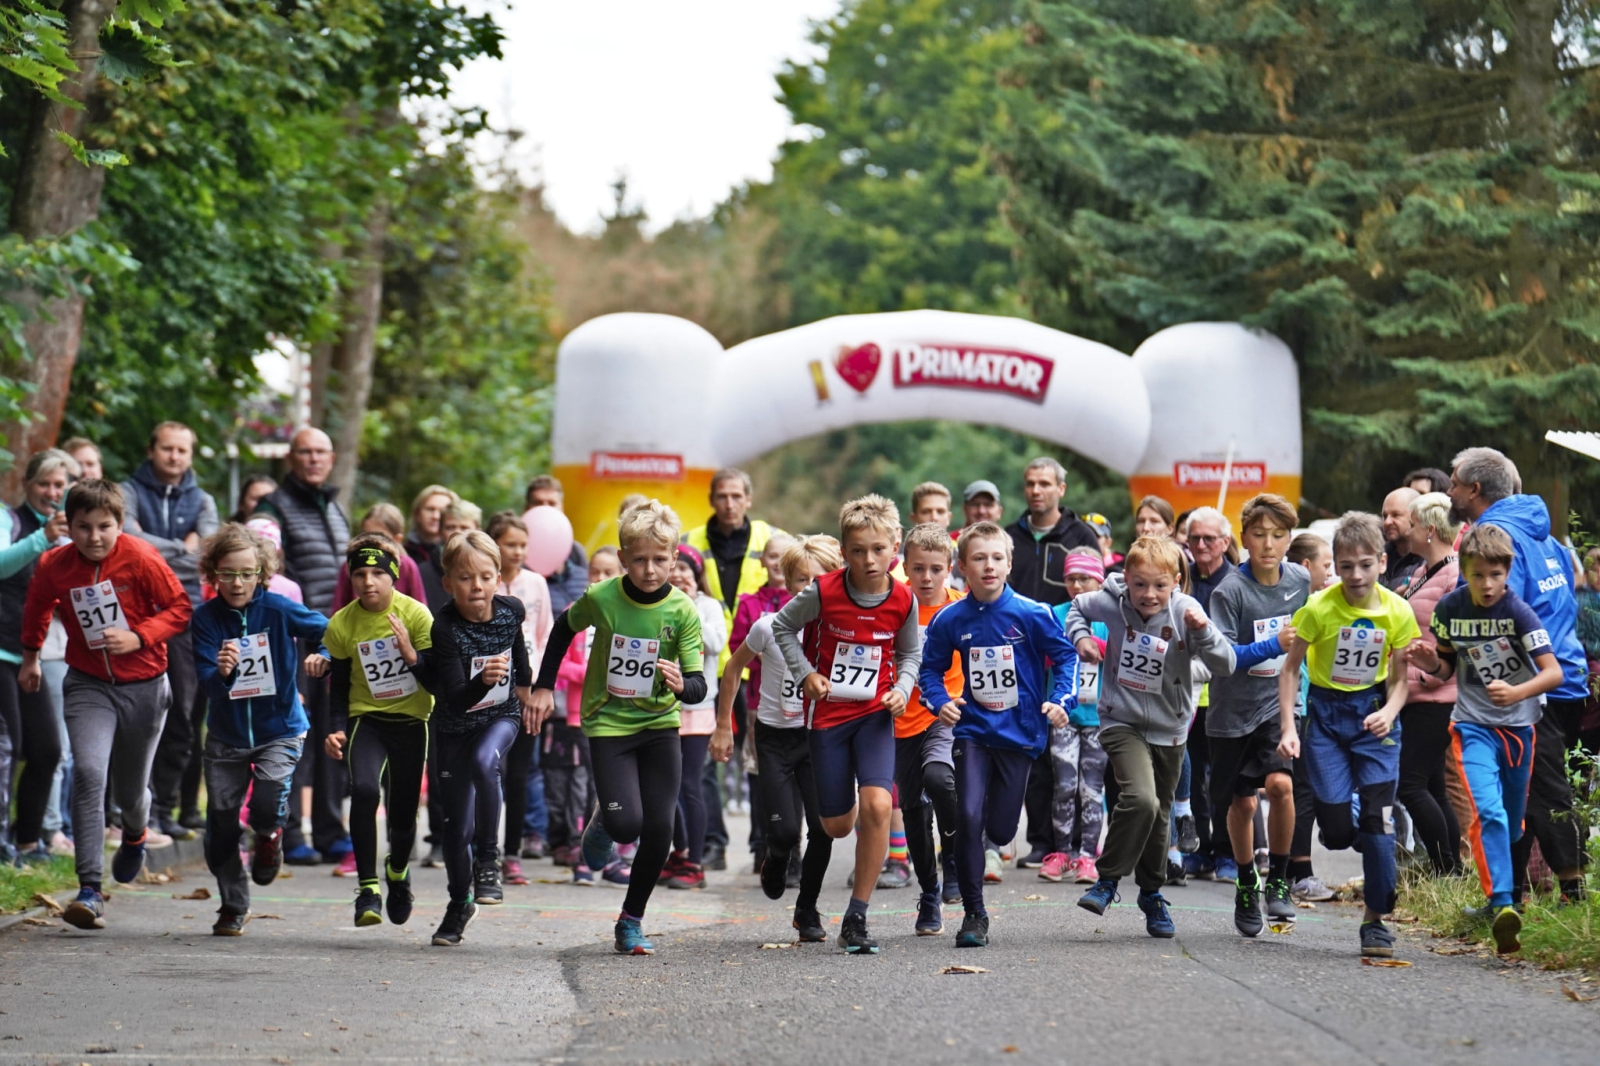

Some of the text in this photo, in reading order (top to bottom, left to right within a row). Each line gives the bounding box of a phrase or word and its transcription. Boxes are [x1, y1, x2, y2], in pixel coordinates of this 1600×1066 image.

[900, 342, 1044, 393] PRIMATOR
[1537, 572, 1568, 594] ROZH
[77, 602, 118, 629] 317
[364, 656, 410, 682] 322
[609, 656, 655, 678] 296
[1120, 649, 1163, 677] 323
[1334, 648, 1380, 668] 316
[831, 663, 878, 688] 377
[971, 669, 1016, 690] 318
[1079, 672, 1097, 687] 57
[1478, 656, 1522, 685] 320
[781, 679, 803, 700] 36
